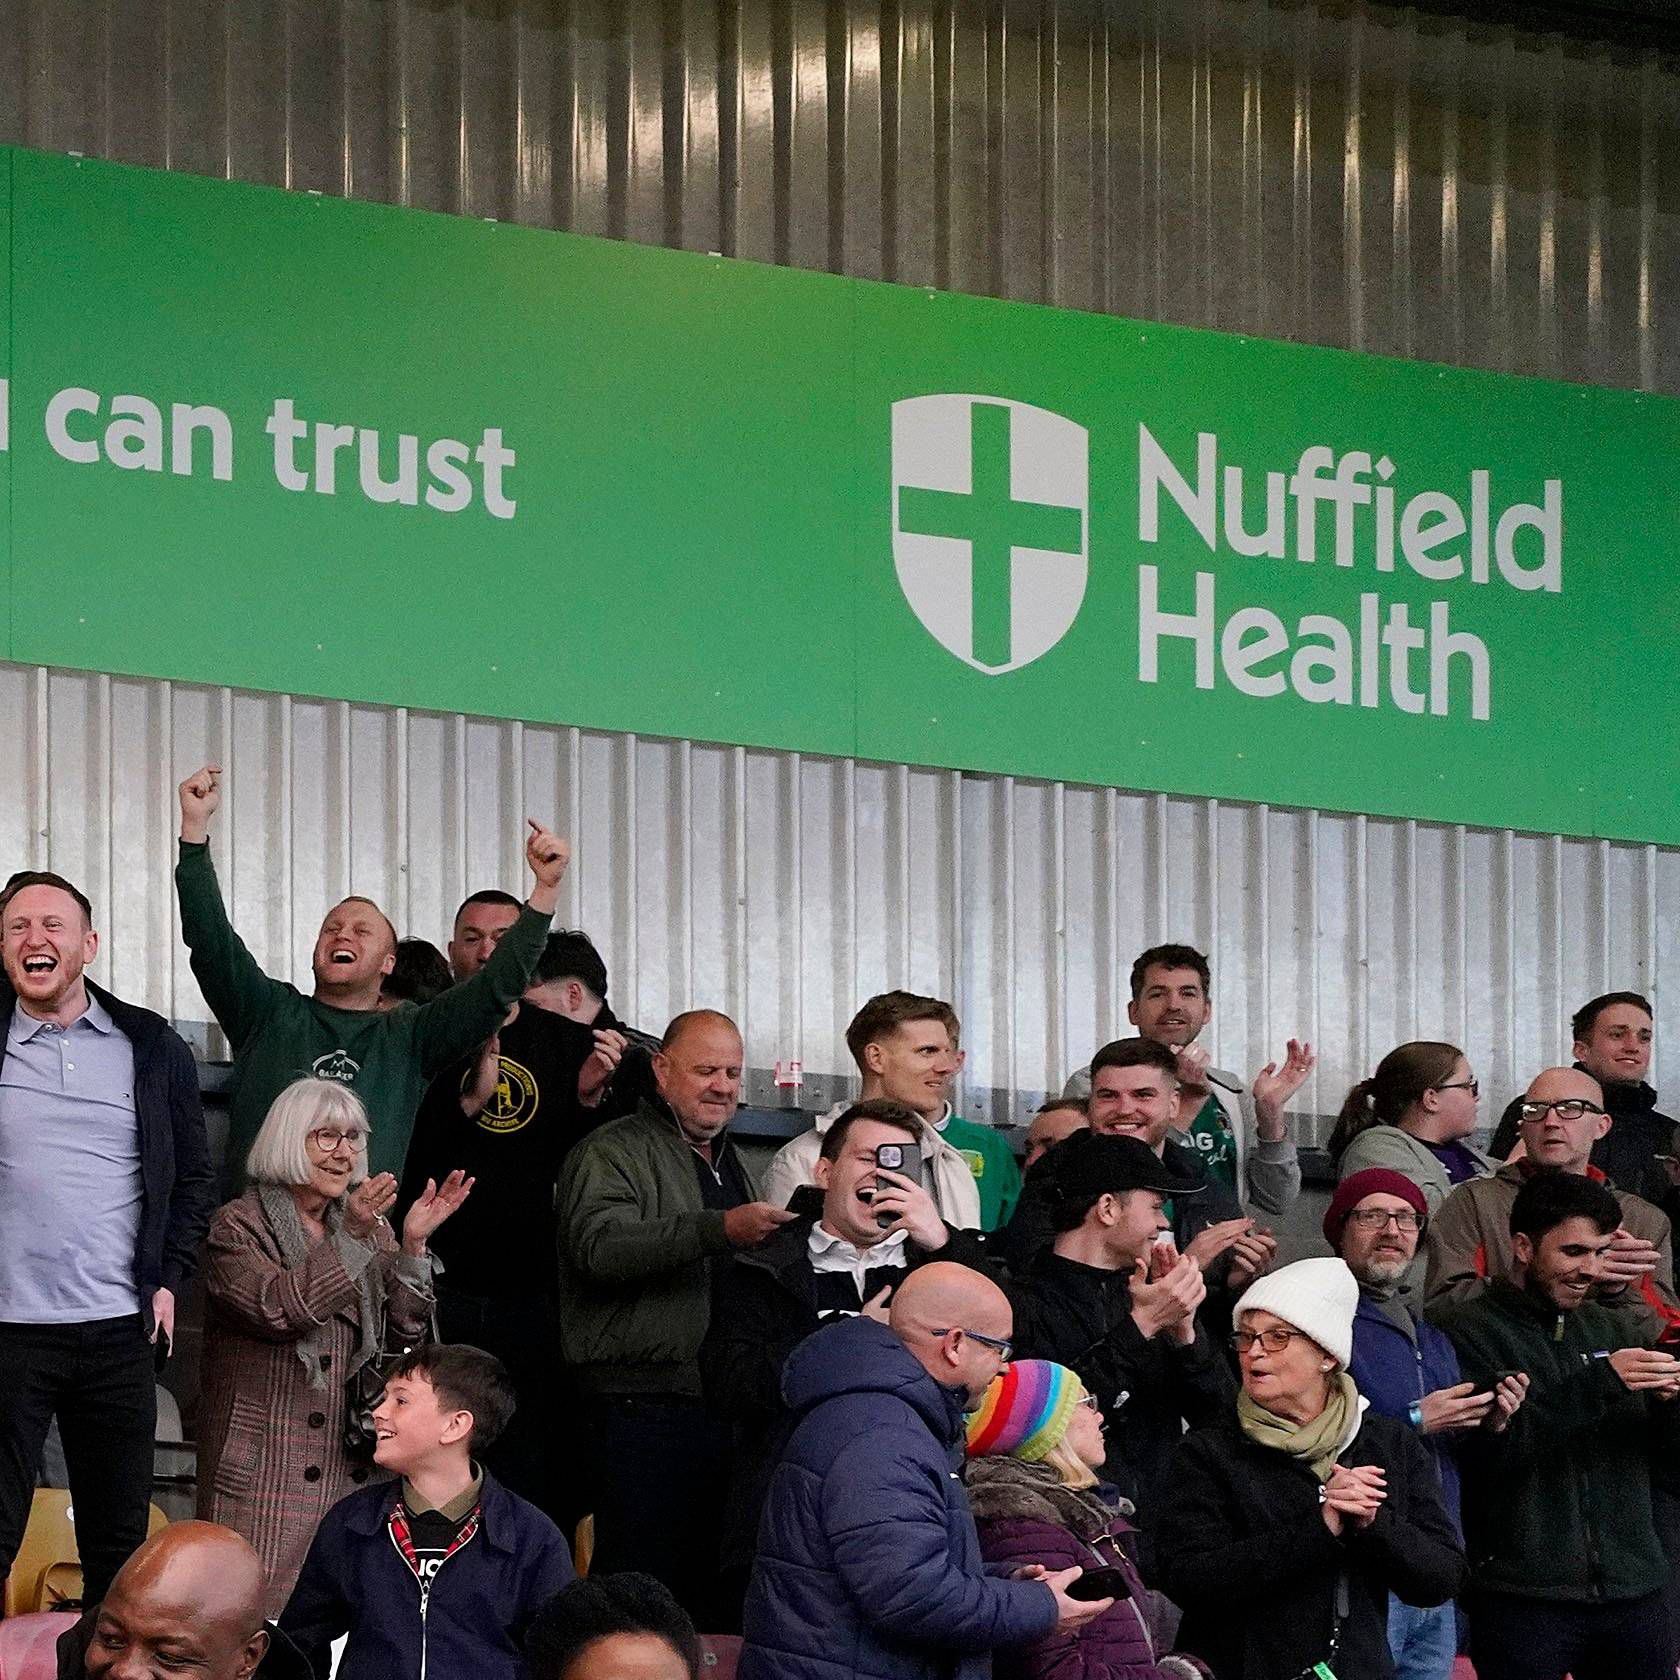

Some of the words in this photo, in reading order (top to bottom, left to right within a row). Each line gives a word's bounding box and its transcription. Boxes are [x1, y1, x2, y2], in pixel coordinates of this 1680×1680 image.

[46, 388, 233, 481] can
[266, 399, 517, 519] trust
[1140, 423, 1562, 593] Nuffield
[1139, 565, 1490, 721] Health
